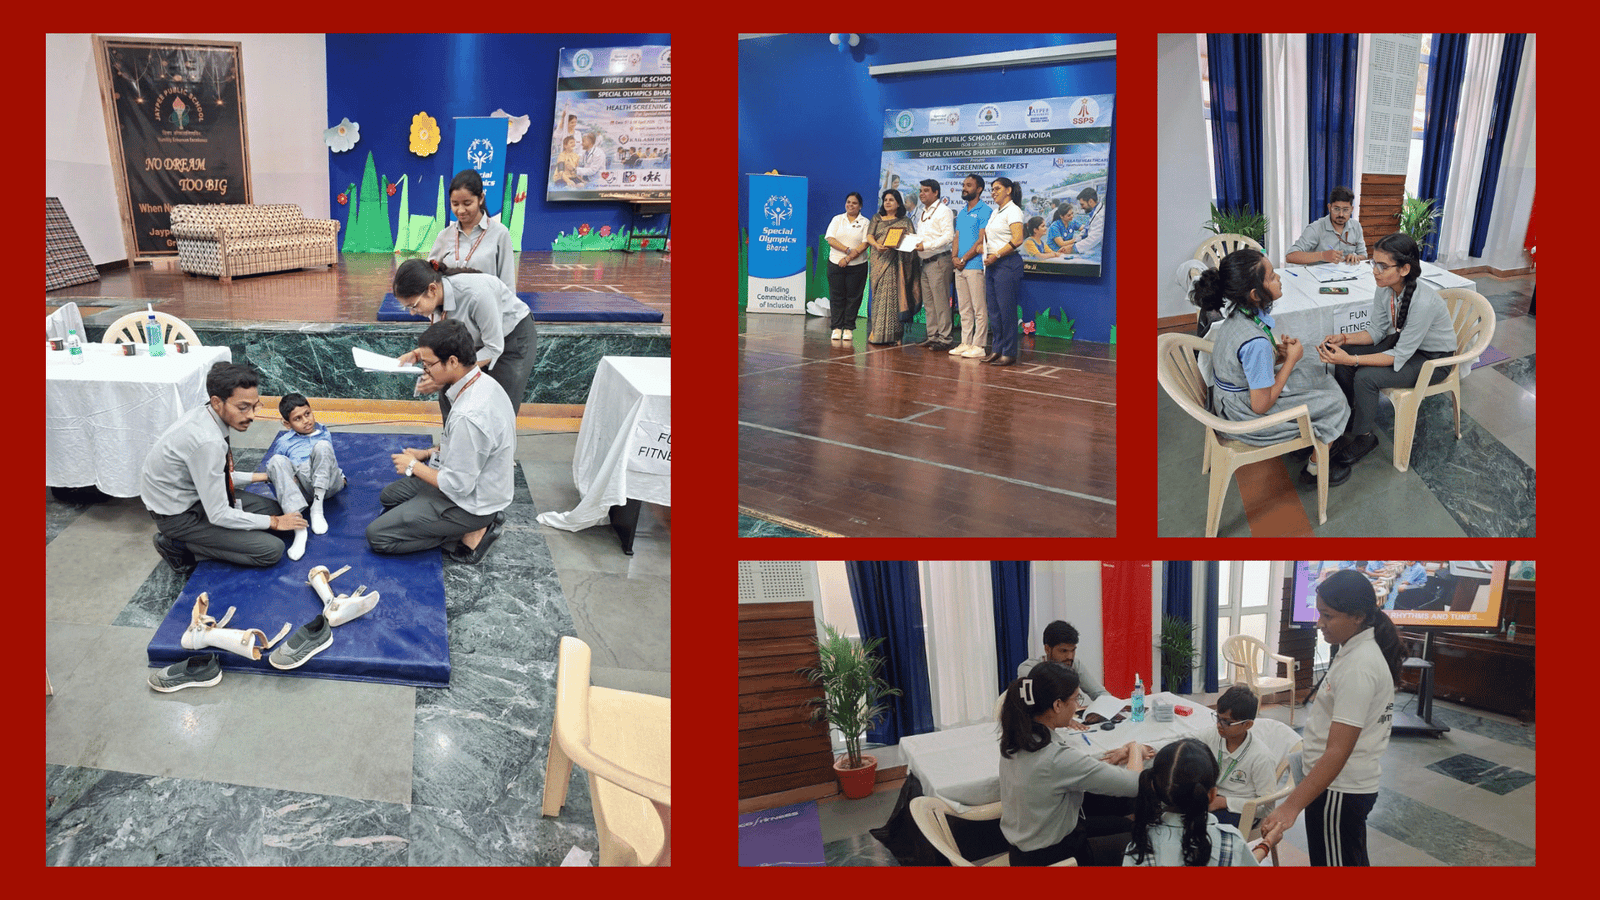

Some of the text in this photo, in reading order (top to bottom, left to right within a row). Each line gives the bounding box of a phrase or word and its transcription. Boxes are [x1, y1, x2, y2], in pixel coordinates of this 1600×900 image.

[155, 87, 204, 122] JAYPEE PUBLIC SCHOOL
[968, 134, 995, 142] SCHOOL,
[997, 132, 1027, 140] GREATER
[145, 158, 206, 172] NO DREAM
[179, 178, 227, 195] TOO BIG
[139, 203, 163, 212] When
[149, 228, 173, 237] Jayp
[763, 227, 793, 235] Special
[759, 235, 797, 243] Olympics
[766, 244, 788, 252] Bharat
[765, 286, 789, 294] Building
[757, 293, 796, 301] Communities
[1349, 310, 1367, 320] FUN
